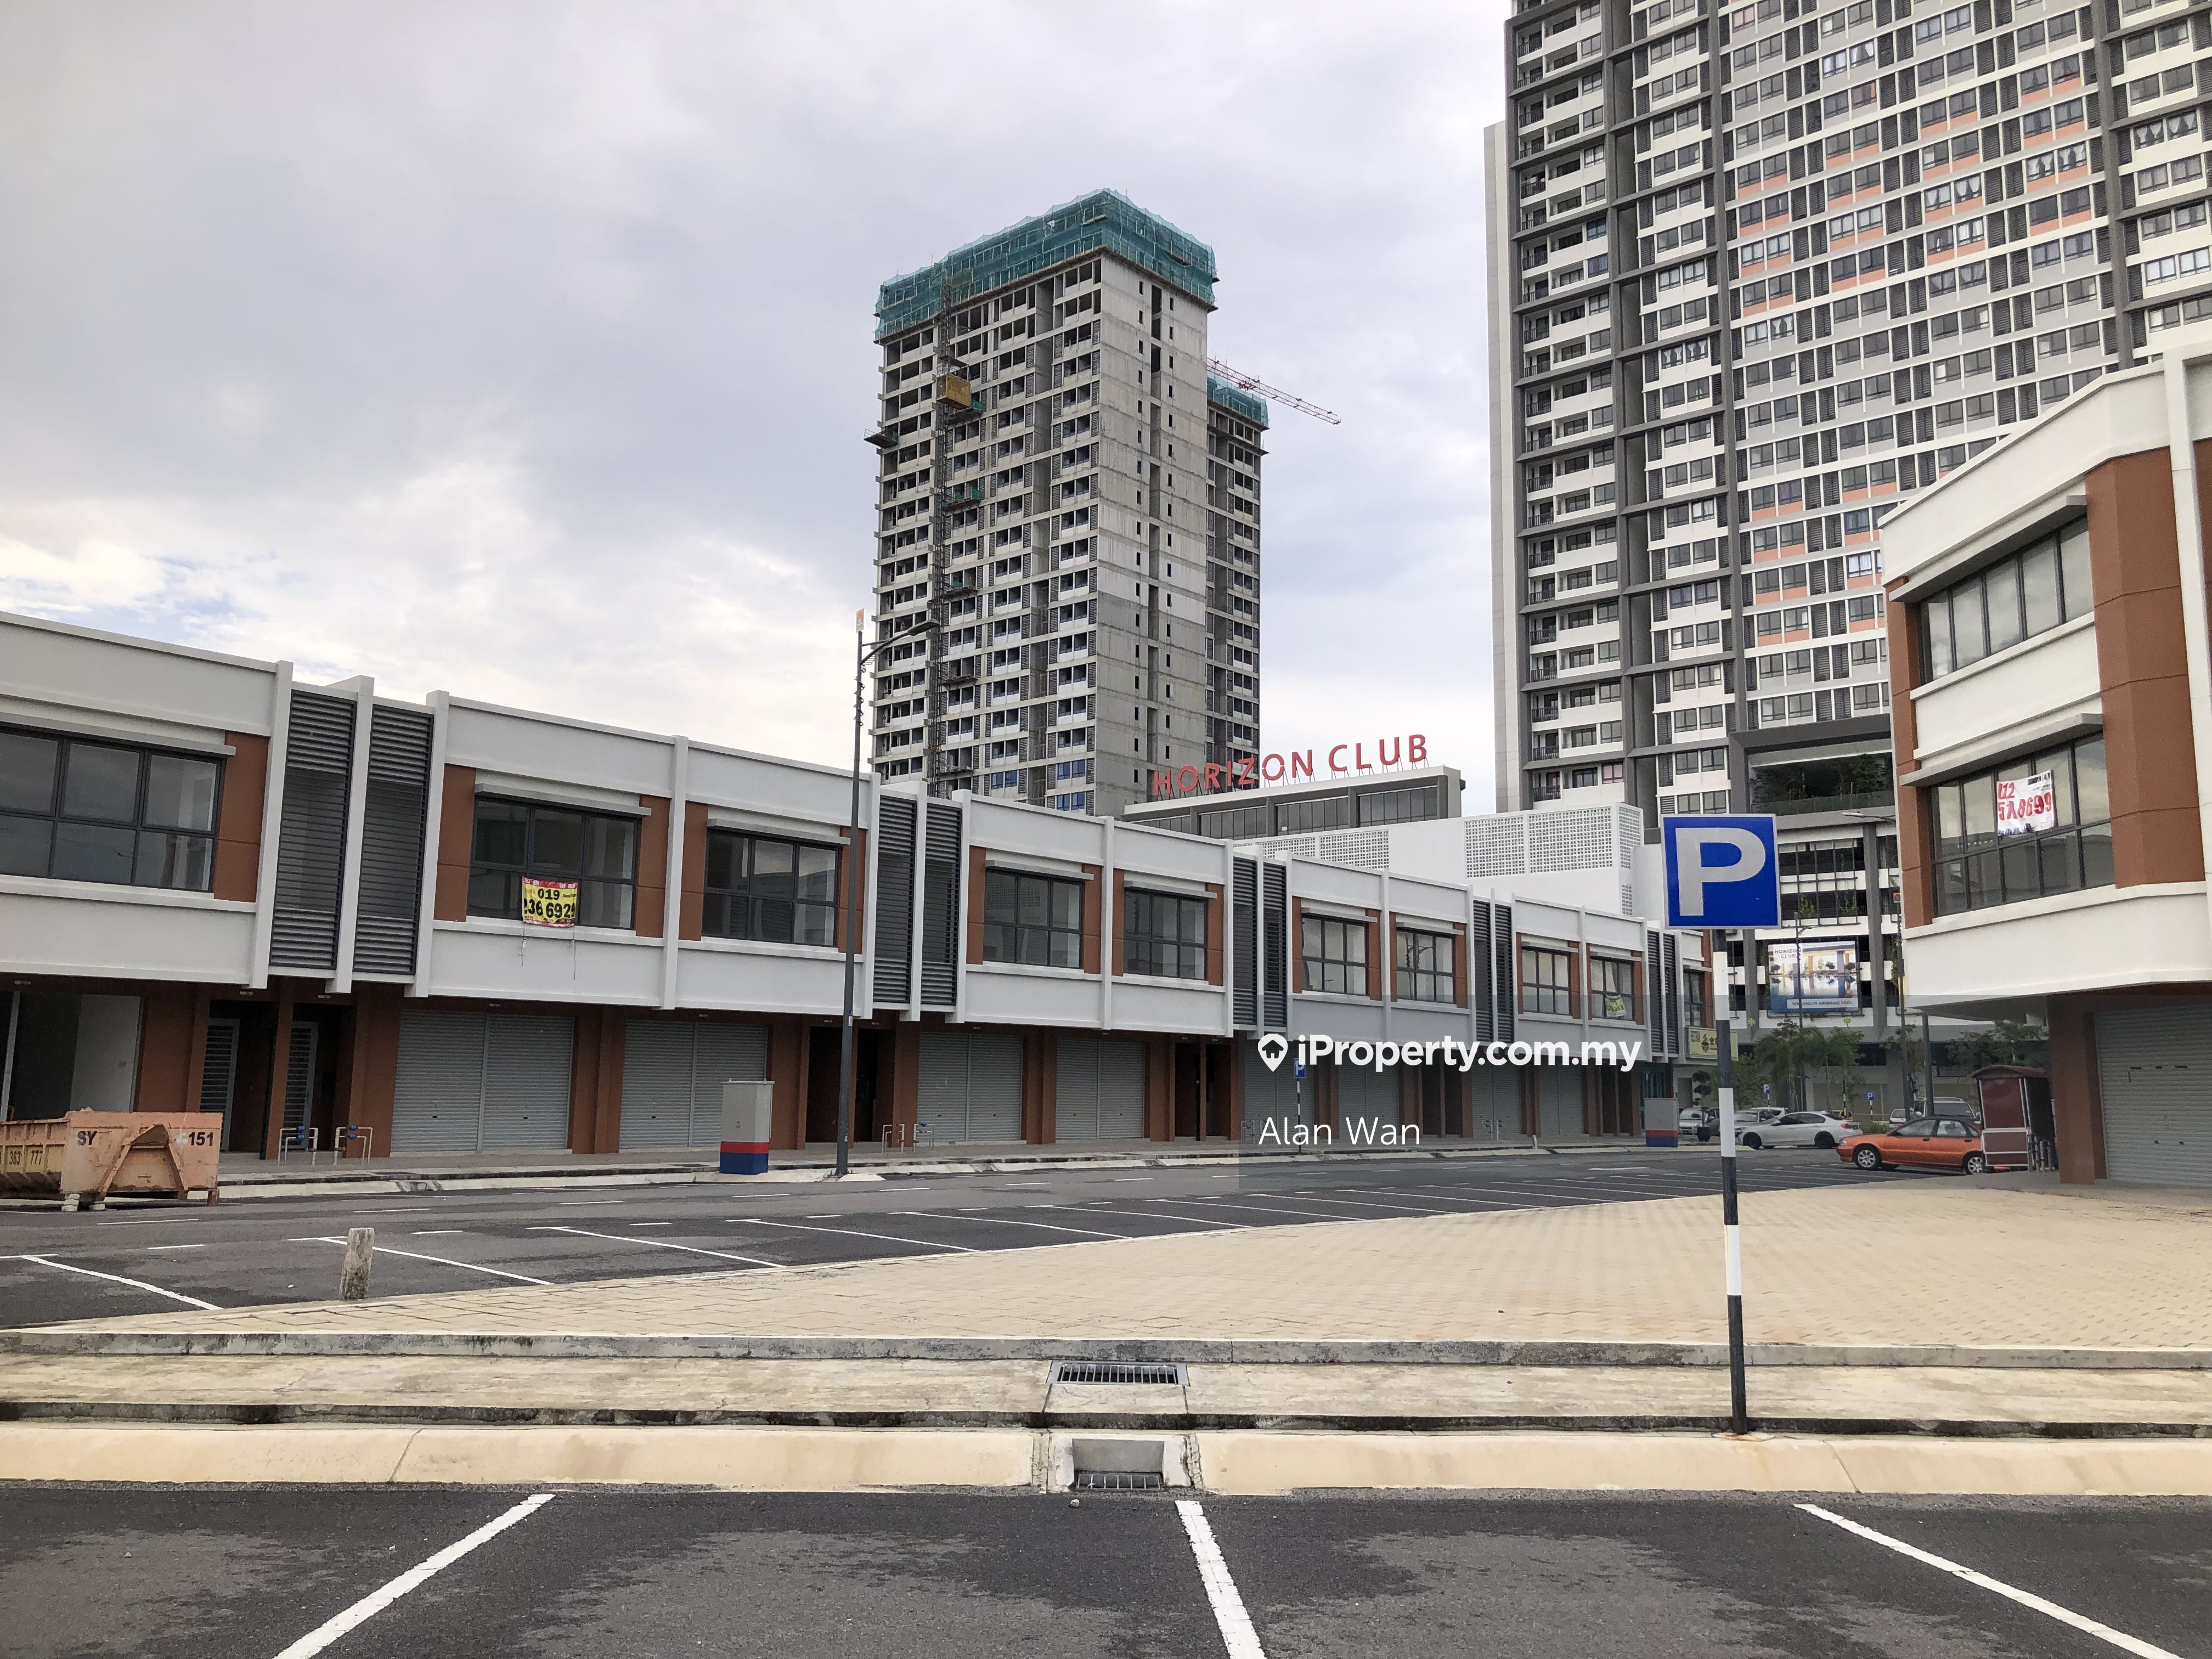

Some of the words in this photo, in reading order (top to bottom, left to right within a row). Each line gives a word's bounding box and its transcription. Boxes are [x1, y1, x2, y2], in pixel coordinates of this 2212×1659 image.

[1153, 749, 1313, 795] HORIZON
[1328, 734, 1427, 772] CLUB
[1675, 827, 1766, 916] P
[537, 888, 560, 900] 019
[77, 1130, 98, 1146] SY
[188, 1131, 214, 1147] 151
